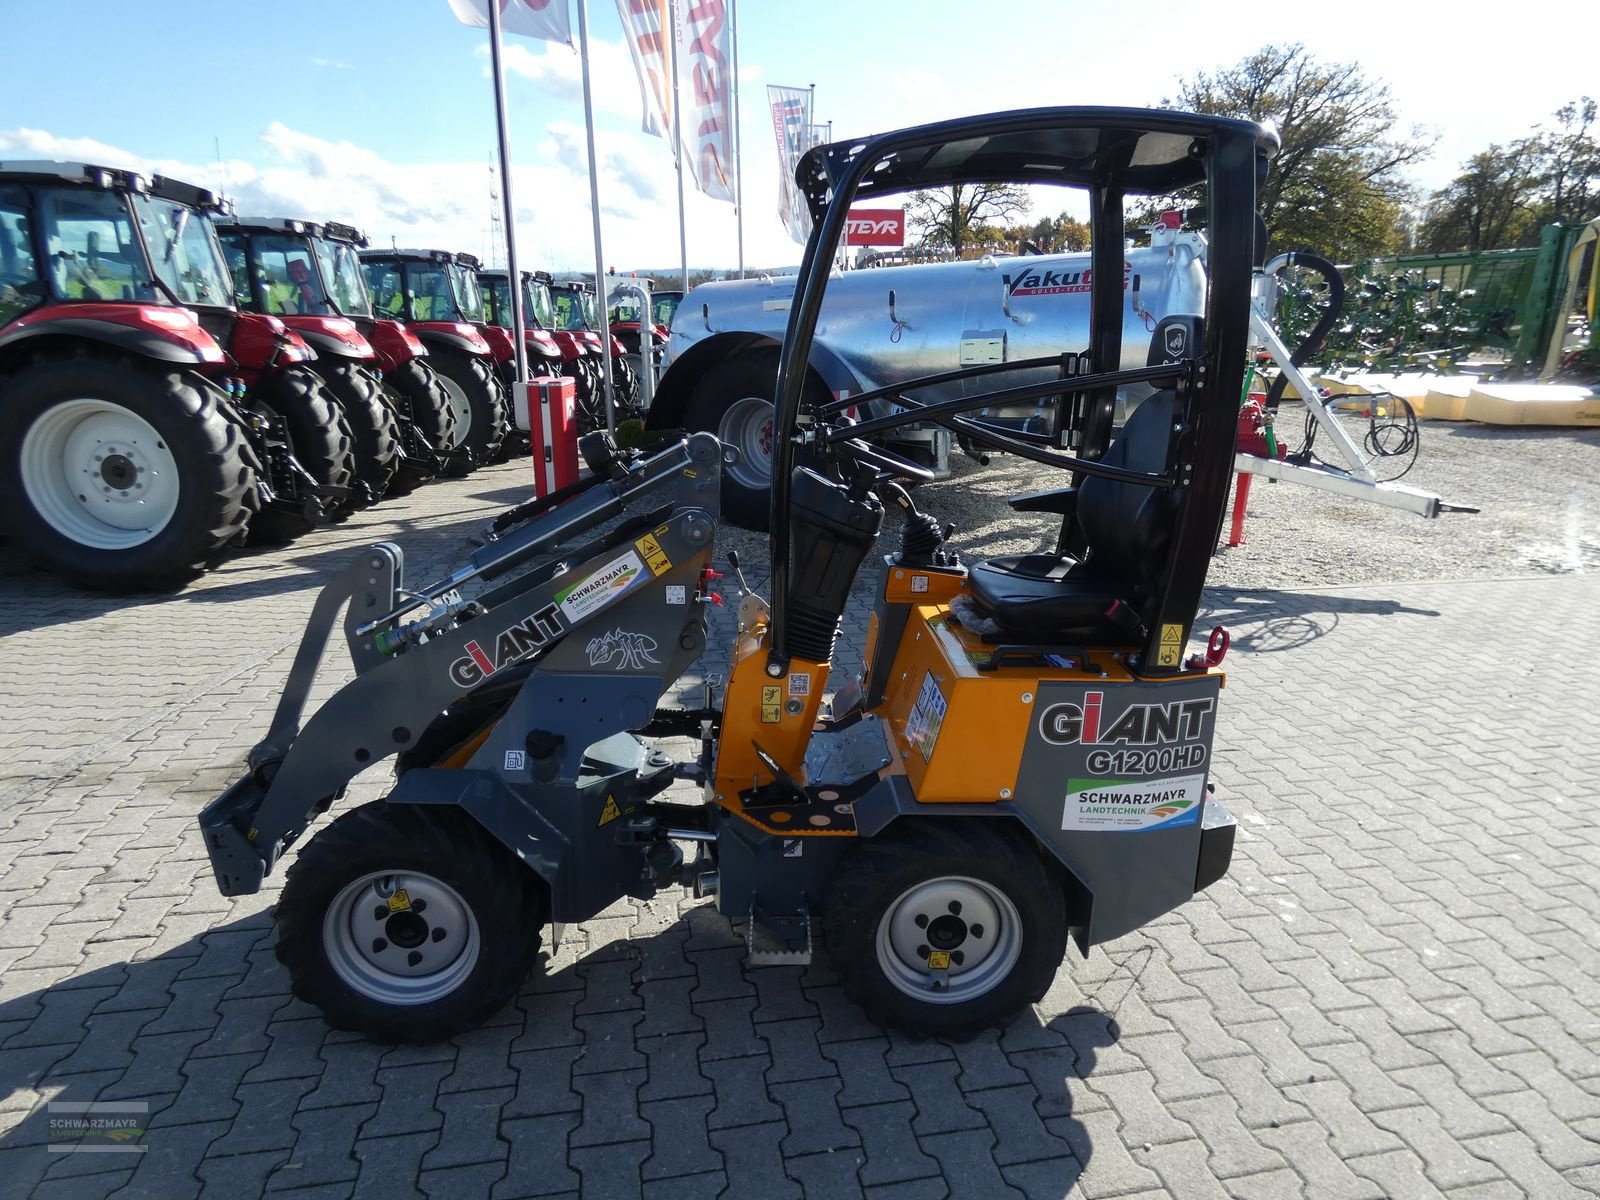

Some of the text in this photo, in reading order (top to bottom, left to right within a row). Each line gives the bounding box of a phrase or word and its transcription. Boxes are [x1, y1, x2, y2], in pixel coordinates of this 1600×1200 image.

[846, 220, 898, 234] TEYR
[1002, 268, 1130, 296] Vakut
[1031, 285, 1092, 295] GÜLLE-TECH
[566, 564, 629, 605] SCHWARZMAYR
[571, 586, 609, 609] LANDTECHNIK
[1086, 744, 1206, 775] G1200HD
[1079, 789, 1186, 805] SCHWARZMAYR
[1080, 806, 1146, 815] LANDTECHNIK
